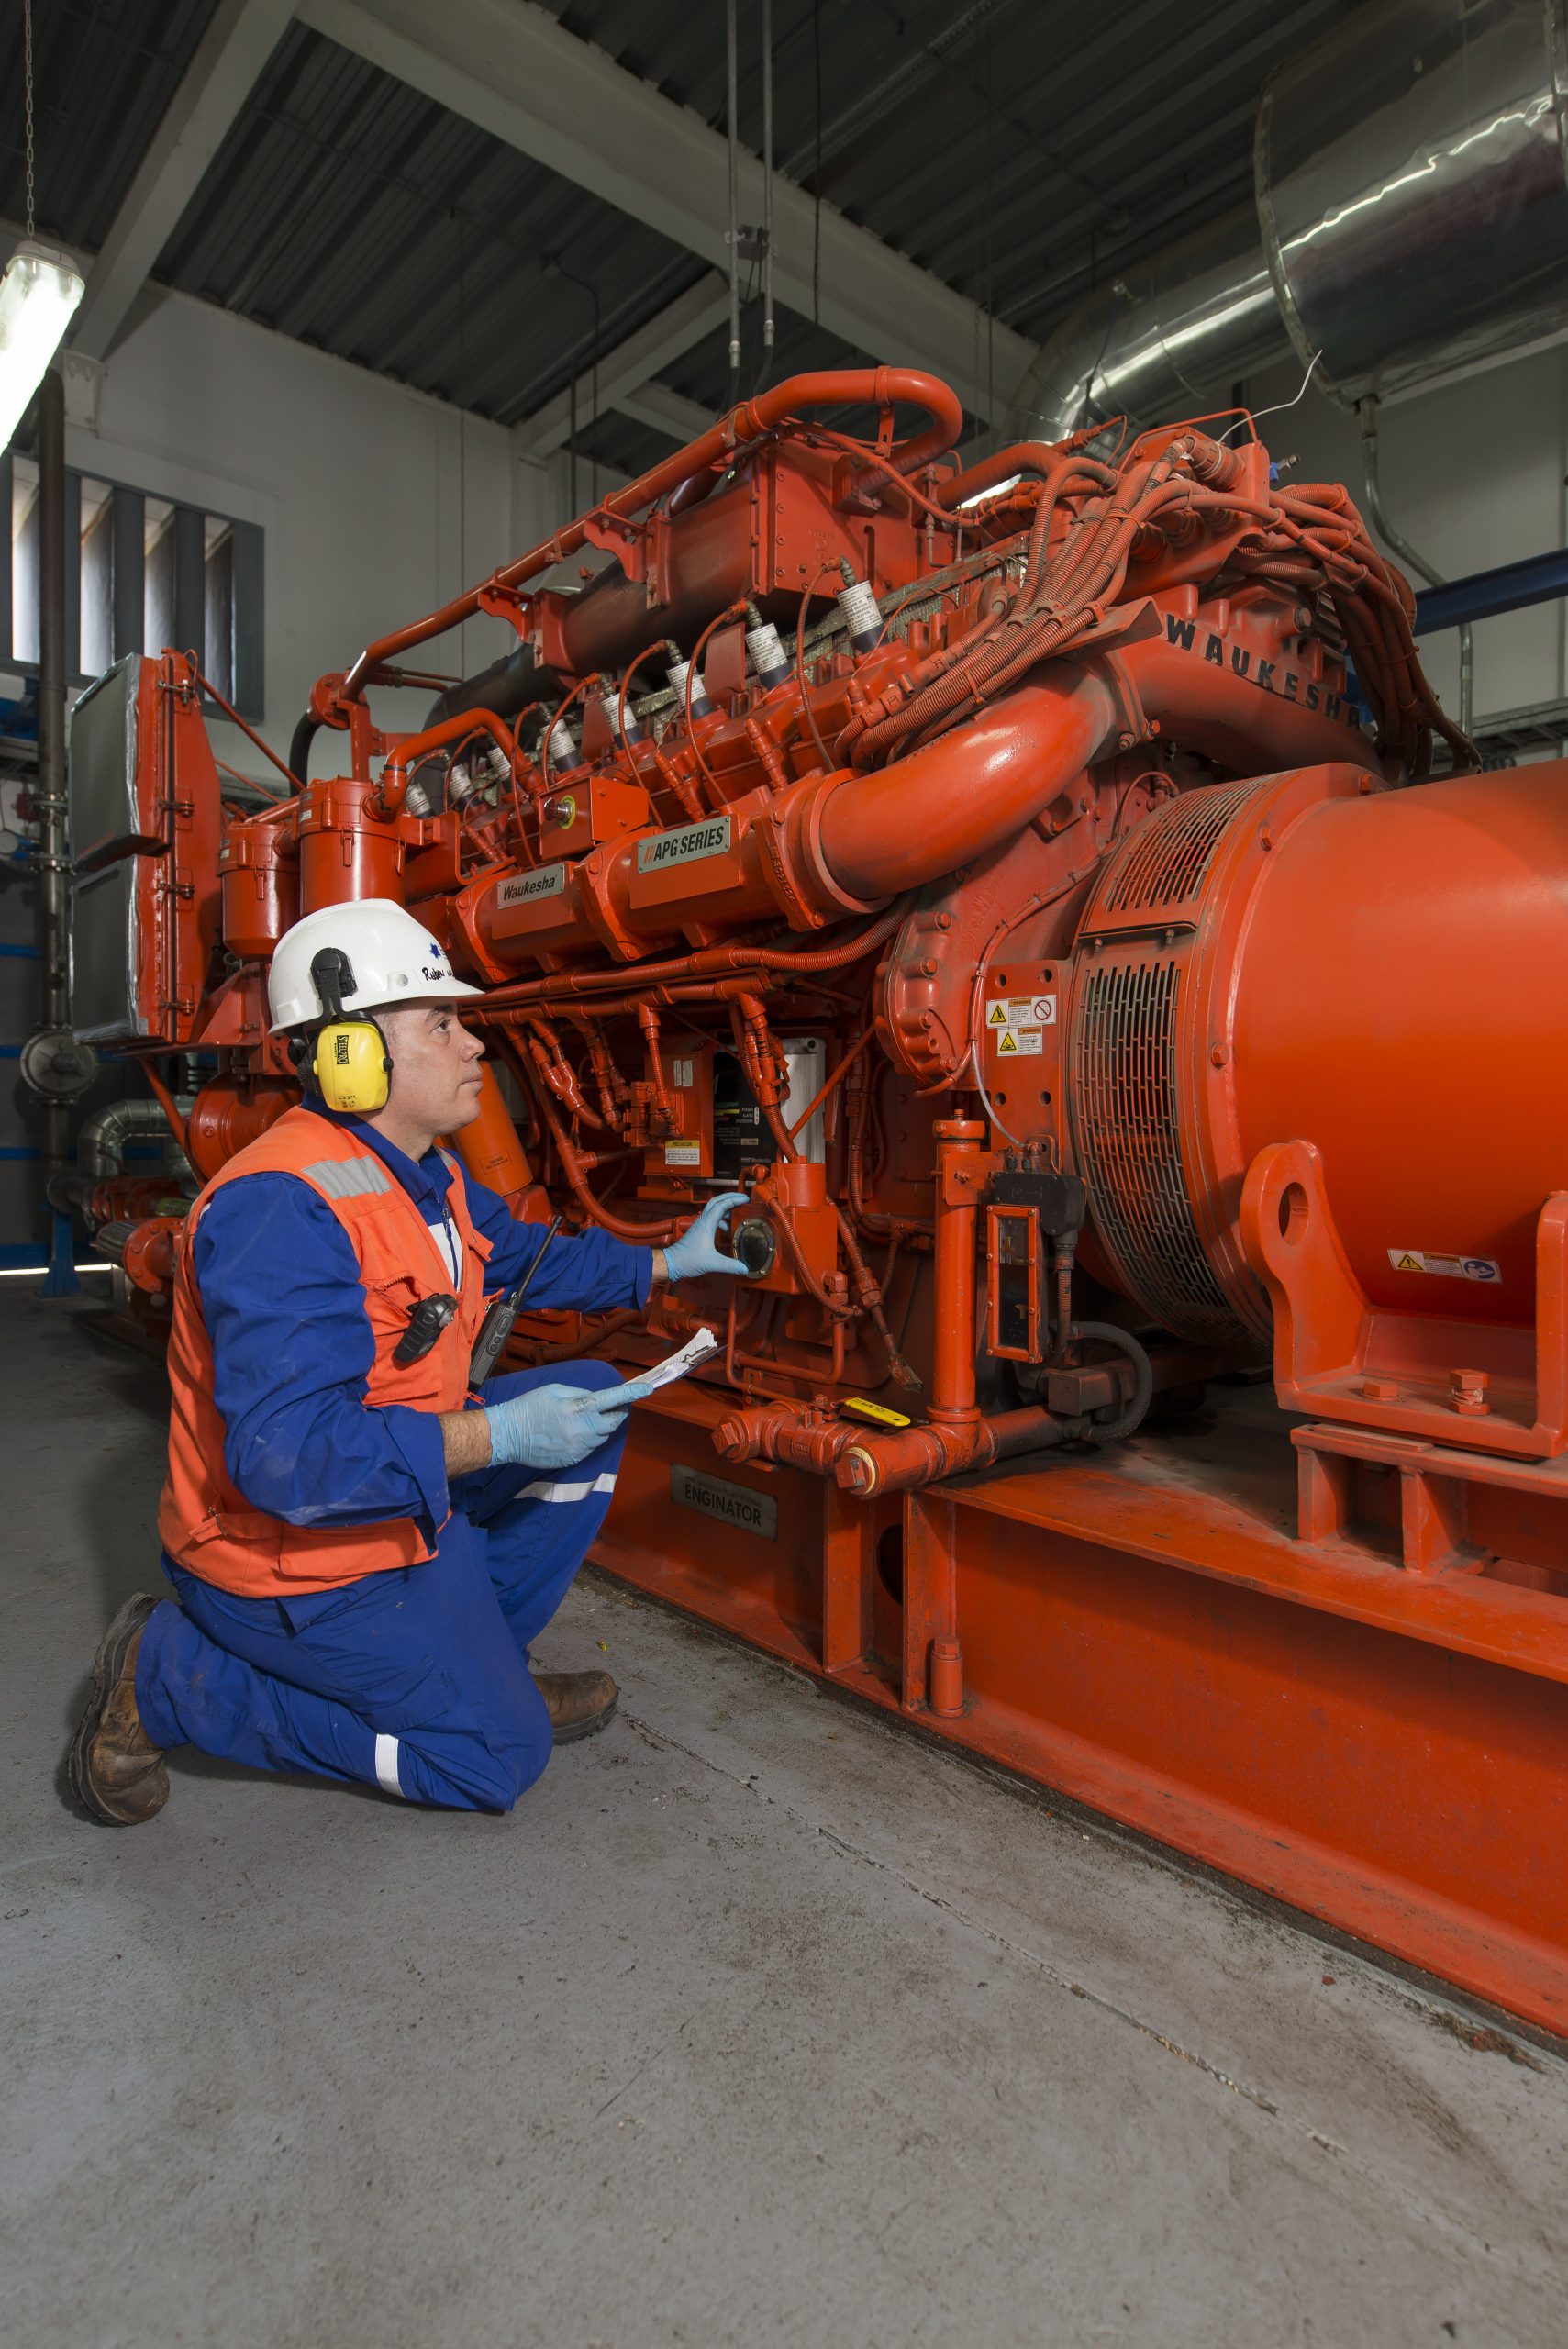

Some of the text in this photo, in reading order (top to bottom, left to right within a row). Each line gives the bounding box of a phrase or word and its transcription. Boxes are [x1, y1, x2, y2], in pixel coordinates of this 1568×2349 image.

[1166, 613, 1361, 731] WAUKESHA
[653, 825, 725, 862] APG SERIES
[503, 875, 556, 901] Waukesha
[337, 1036, 350, 1064] STEELPRO
[684, 1483, 762, 1527] ENGINATOR
